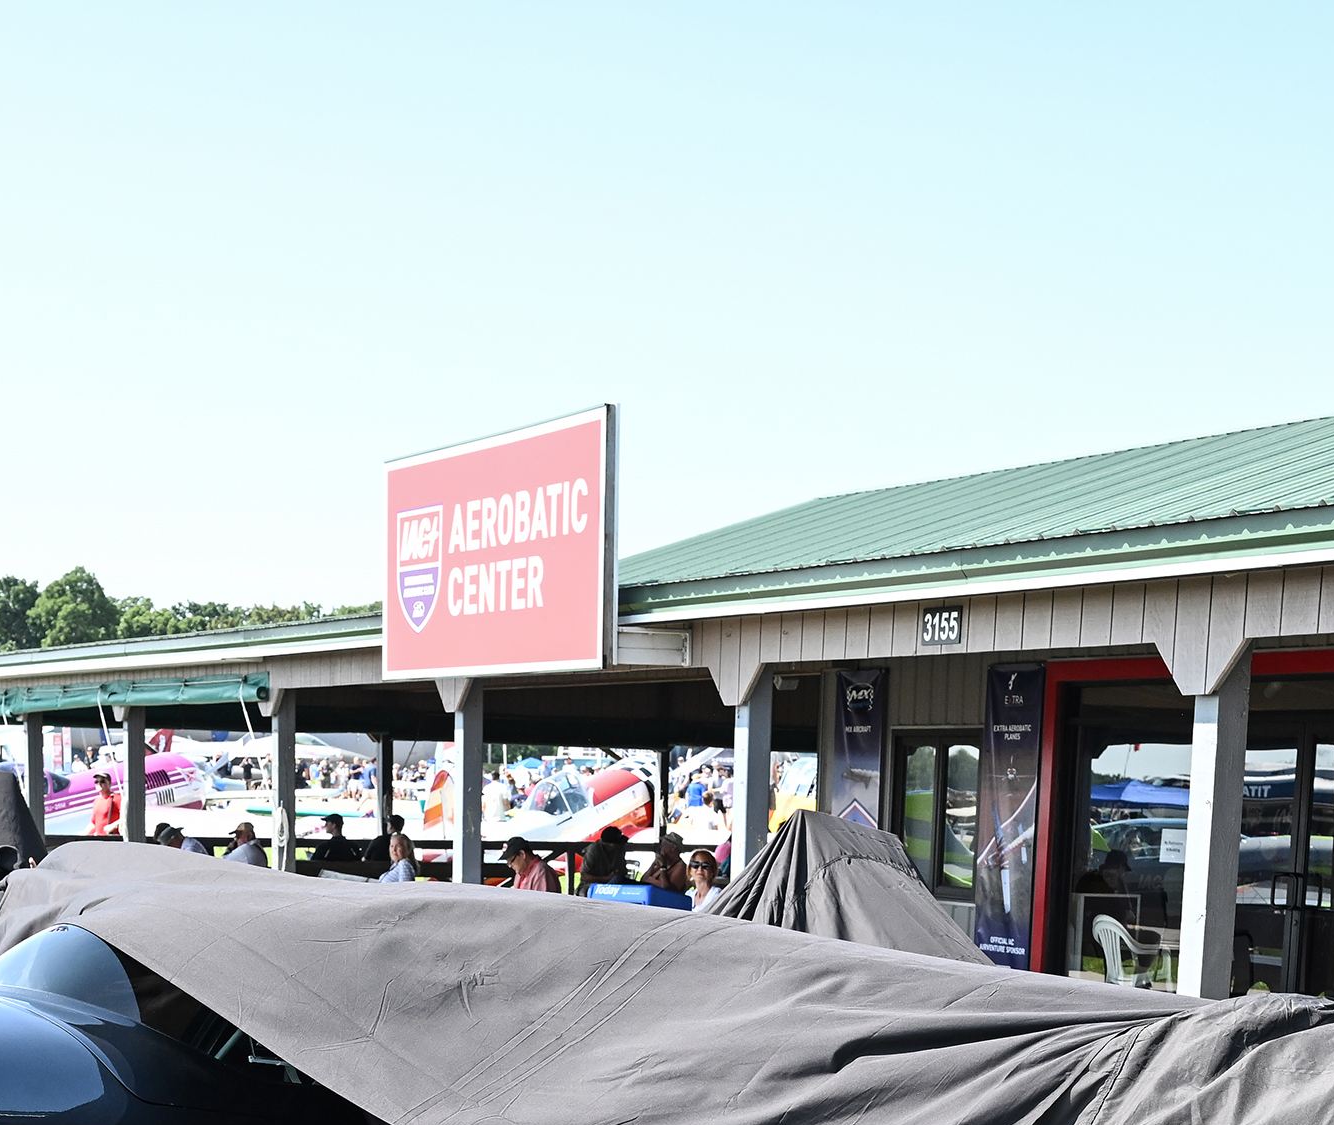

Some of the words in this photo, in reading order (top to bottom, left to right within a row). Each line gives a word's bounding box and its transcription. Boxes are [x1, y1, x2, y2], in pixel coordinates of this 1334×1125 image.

[448, 478, 588, 554] AEROBATIC
[448, 556, 544, 616] CENTER
[923, 612, 958, 642] 3155
[1004, 696, 1024, 704] EXTRA
[595, 884, 620, 897] Today
[990, 936, 1007, 945] OFFICIAL
[980, 944, 1005, 953] AIRVENTURE
[1006, 946, 1025, 955] SPONSOR
